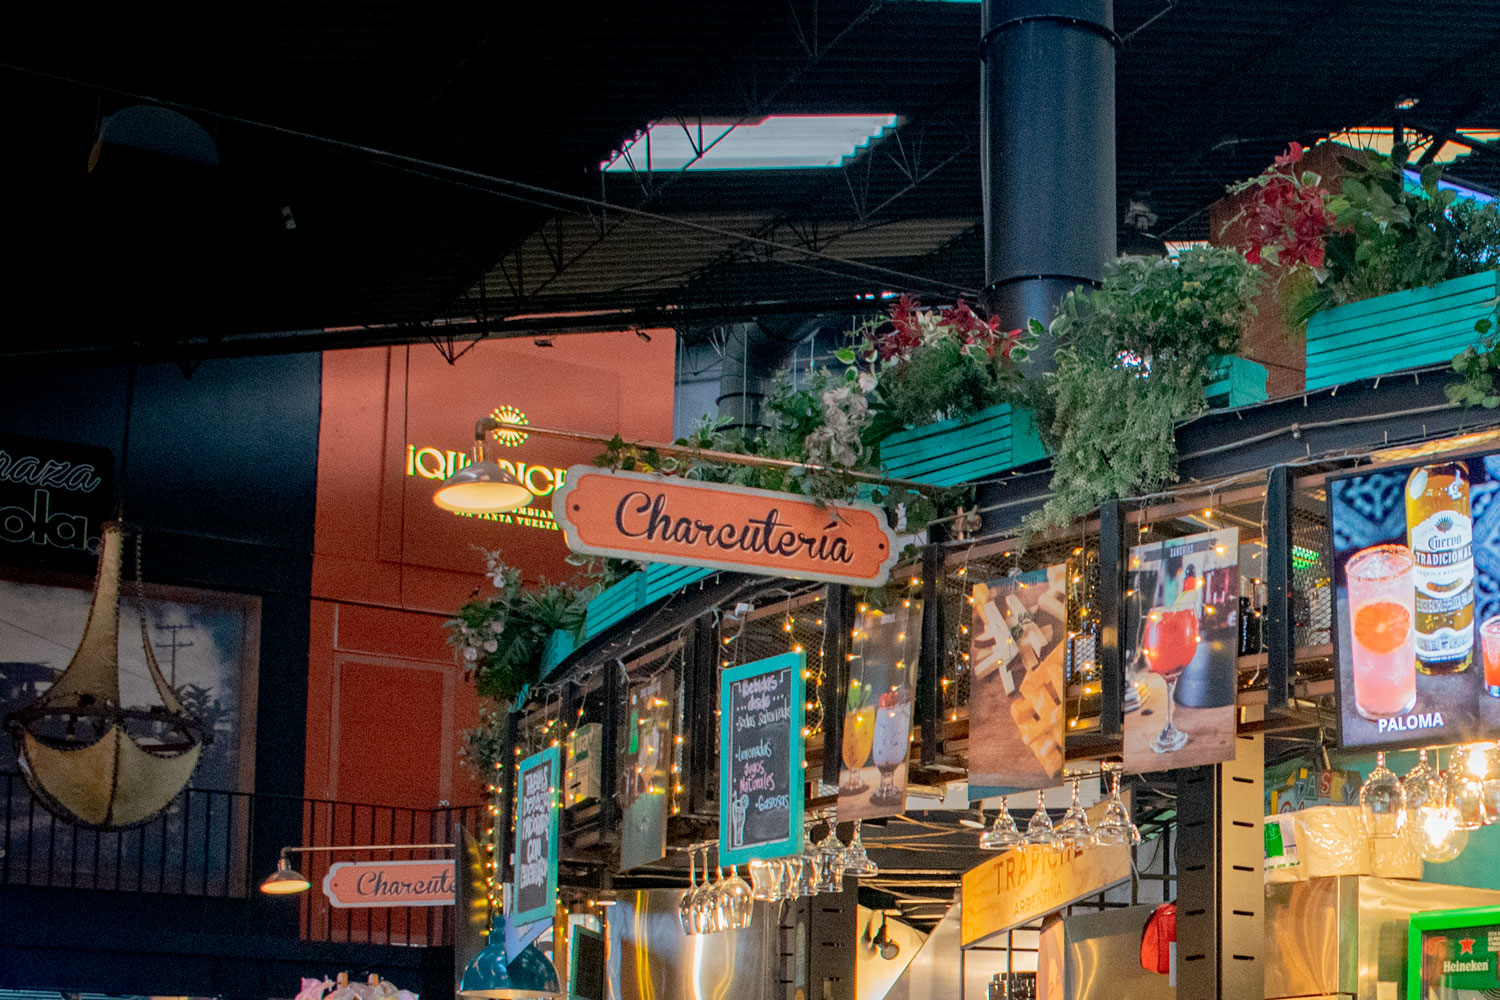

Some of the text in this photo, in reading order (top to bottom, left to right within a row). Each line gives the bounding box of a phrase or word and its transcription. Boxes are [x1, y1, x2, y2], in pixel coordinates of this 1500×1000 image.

[516, 515, 559, 531] VUELTA
[615, 491, 854, 564] Charcutería
[1416, 548, 1473, 566] TRADICIONAL
[1377, 713, 1444, 733] PALOMA
[1443, 960, 1488, 972] Heineken
